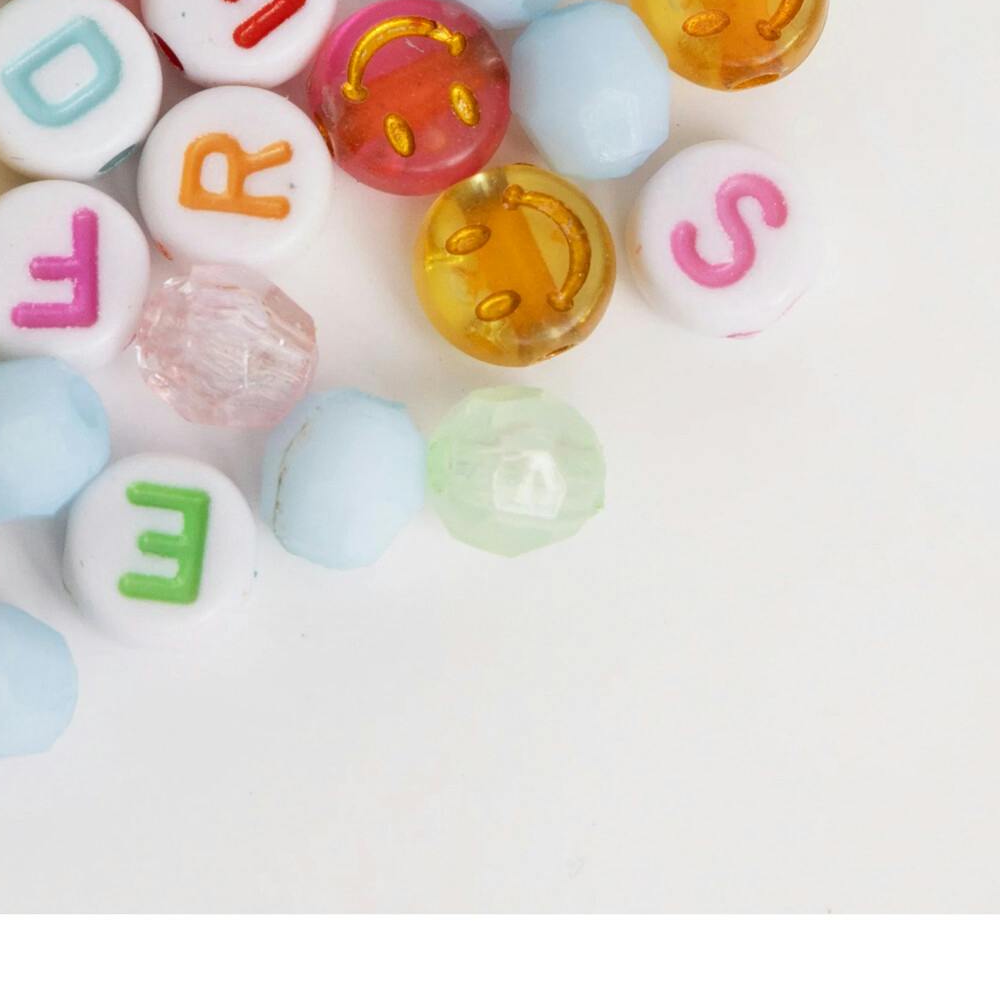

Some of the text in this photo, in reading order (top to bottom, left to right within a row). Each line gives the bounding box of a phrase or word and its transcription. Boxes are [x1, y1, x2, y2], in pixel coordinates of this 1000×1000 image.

[2, 16, 121, 127] D
[178, 132, 293, 221] R
[671, 175, 787, 288] S
[11, 208, 99, 328] F
[119, 483, 209, 604] E
